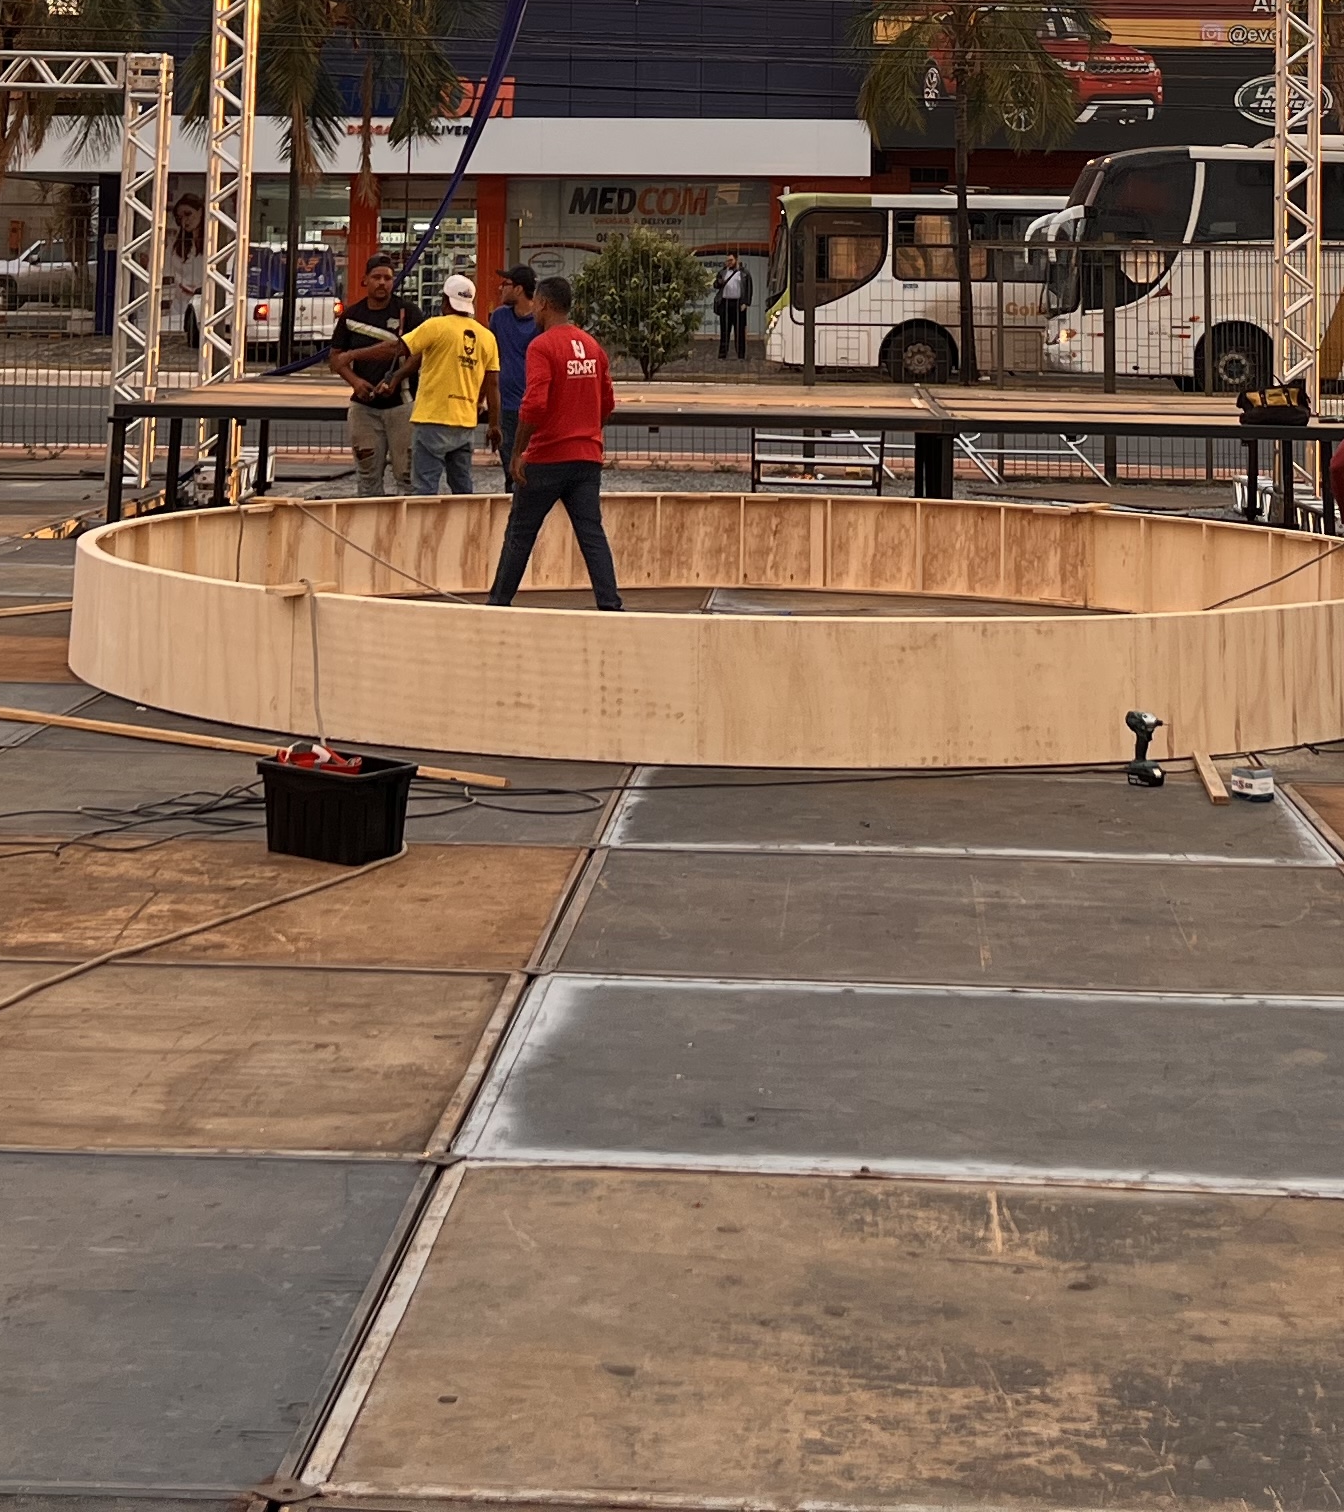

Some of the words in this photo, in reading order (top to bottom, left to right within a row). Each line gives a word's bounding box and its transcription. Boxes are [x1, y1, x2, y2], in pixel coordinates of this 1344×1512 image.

[568, 187, 707, 216] MEDCOM
[641, 217, 682, 225] DELIVERY
[567, 359, 597, 376] START
